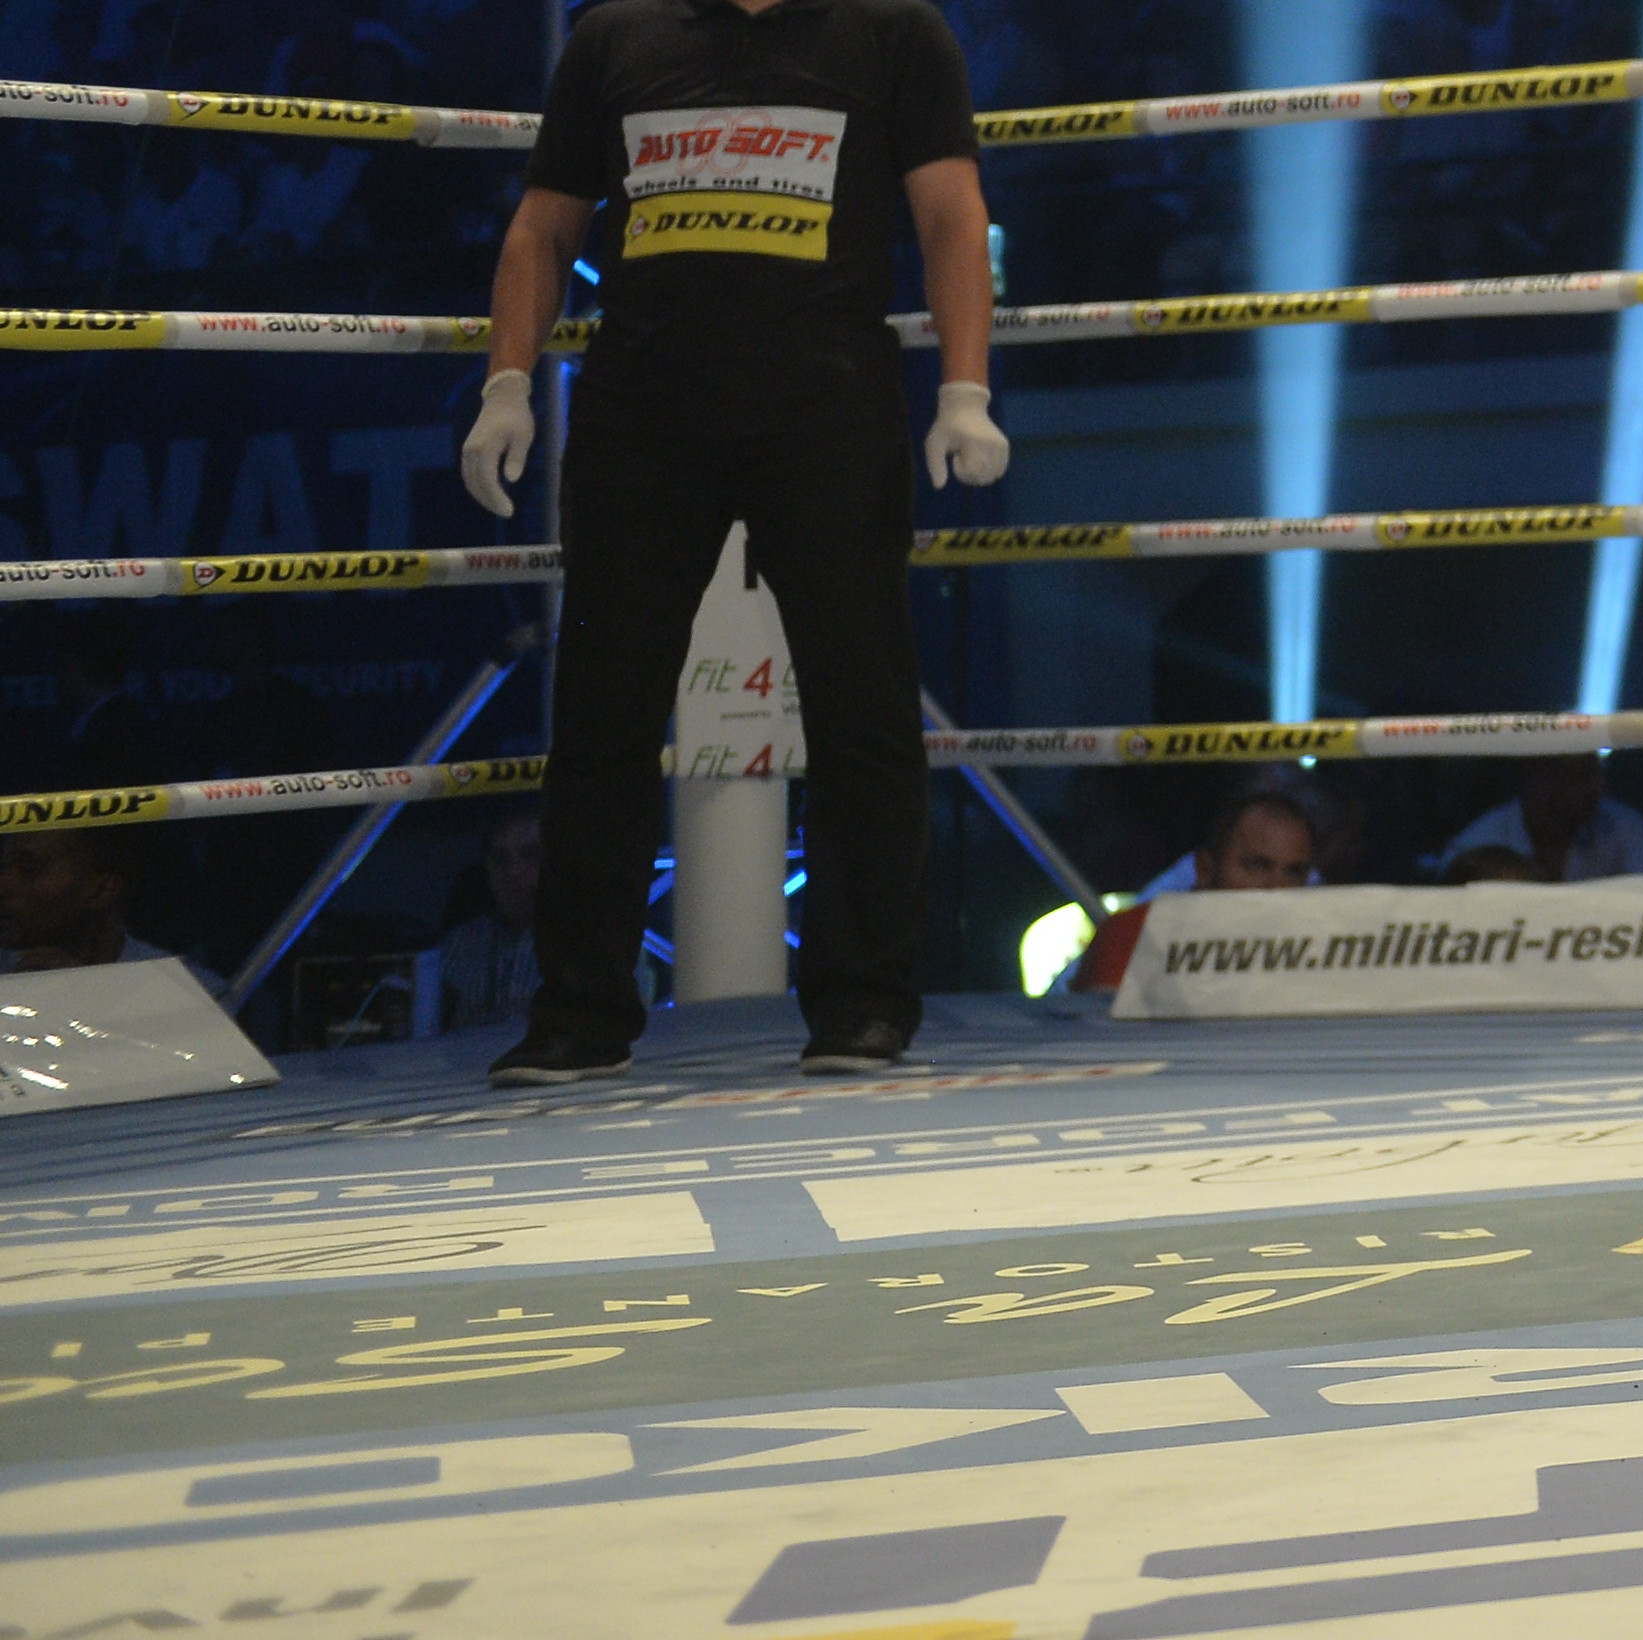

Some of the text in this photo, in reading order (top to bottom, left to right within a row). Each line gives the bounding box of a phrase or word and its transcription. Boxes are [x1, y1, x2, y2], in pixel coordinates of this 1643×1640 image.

[1428, 72, 1615, 107] DUNLOP
[219, 94, 400, 128] DUNLOP
[1165, 89, 1362, 122] www.auto-soft.ro
[634, 127, 722, 167] AUTO
[631, 174, 827, 198] wheels and tires
[653, 210, 820, 239] DUNLOP
[1400, 271, 1602, 300] www.auto-soft.ro
[992, 300, 1112, 330] uto-soft.ro
[1178, 288, 1366, 326] DUNLOP
[199, 312, 407, 336] www.auto-soft.ro
[1158, 515, 1356, 541] www.auto-soft.ro
[1425, 506, 1612, 536] DUNLOP
[945, 525, 1126, 552] DUNLOP
[230, 551, 421, 584] DUNLOP
[743, 656, 774, 700] 4
[1383, 712, 1592, 739] www.auto-soft.ro
[1164, 729, 1344, 759] DUNLOP
[203, 766, 413, 802] www.auto-soft.ro
[894, 1247, 1531, 1327] La
